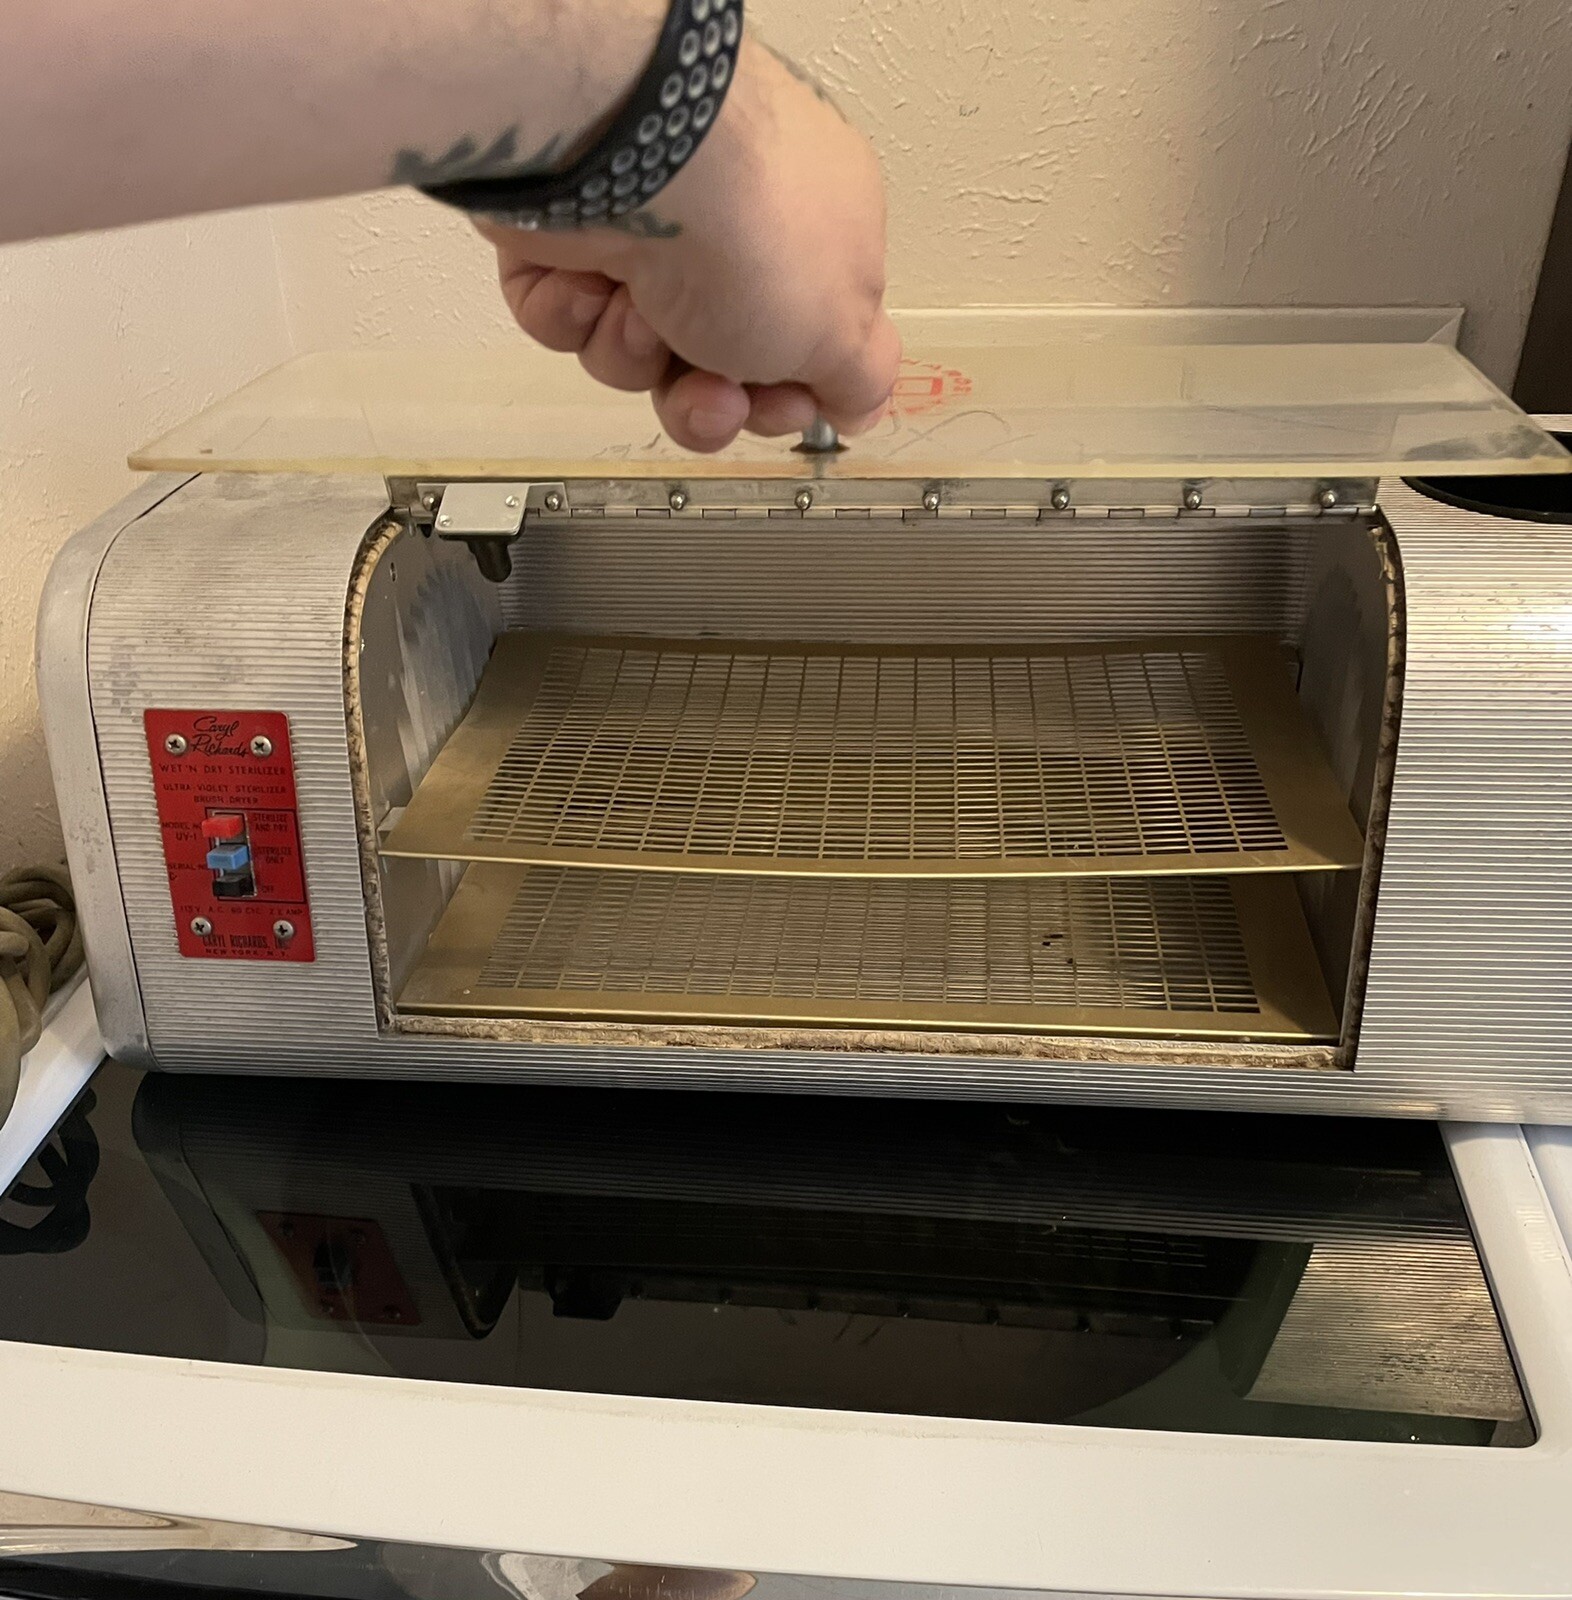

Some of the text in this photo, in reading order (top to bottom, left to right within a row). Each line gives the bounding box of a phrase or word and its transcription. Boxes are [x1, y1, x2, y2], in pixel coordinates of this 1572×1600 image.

[193, 715, 240, 741] Caryl
[191, 734, 249, 757] Richards
[159, 764, 182, 773] WET
[204, 765, 222, 774] DRY
[229, 766, 287, 776] STERILIZER
[236, 785, 287, 794] STERILIZER
[202, 934, 226, 947] CARYL
[205, 948, 227, 956] NEW
